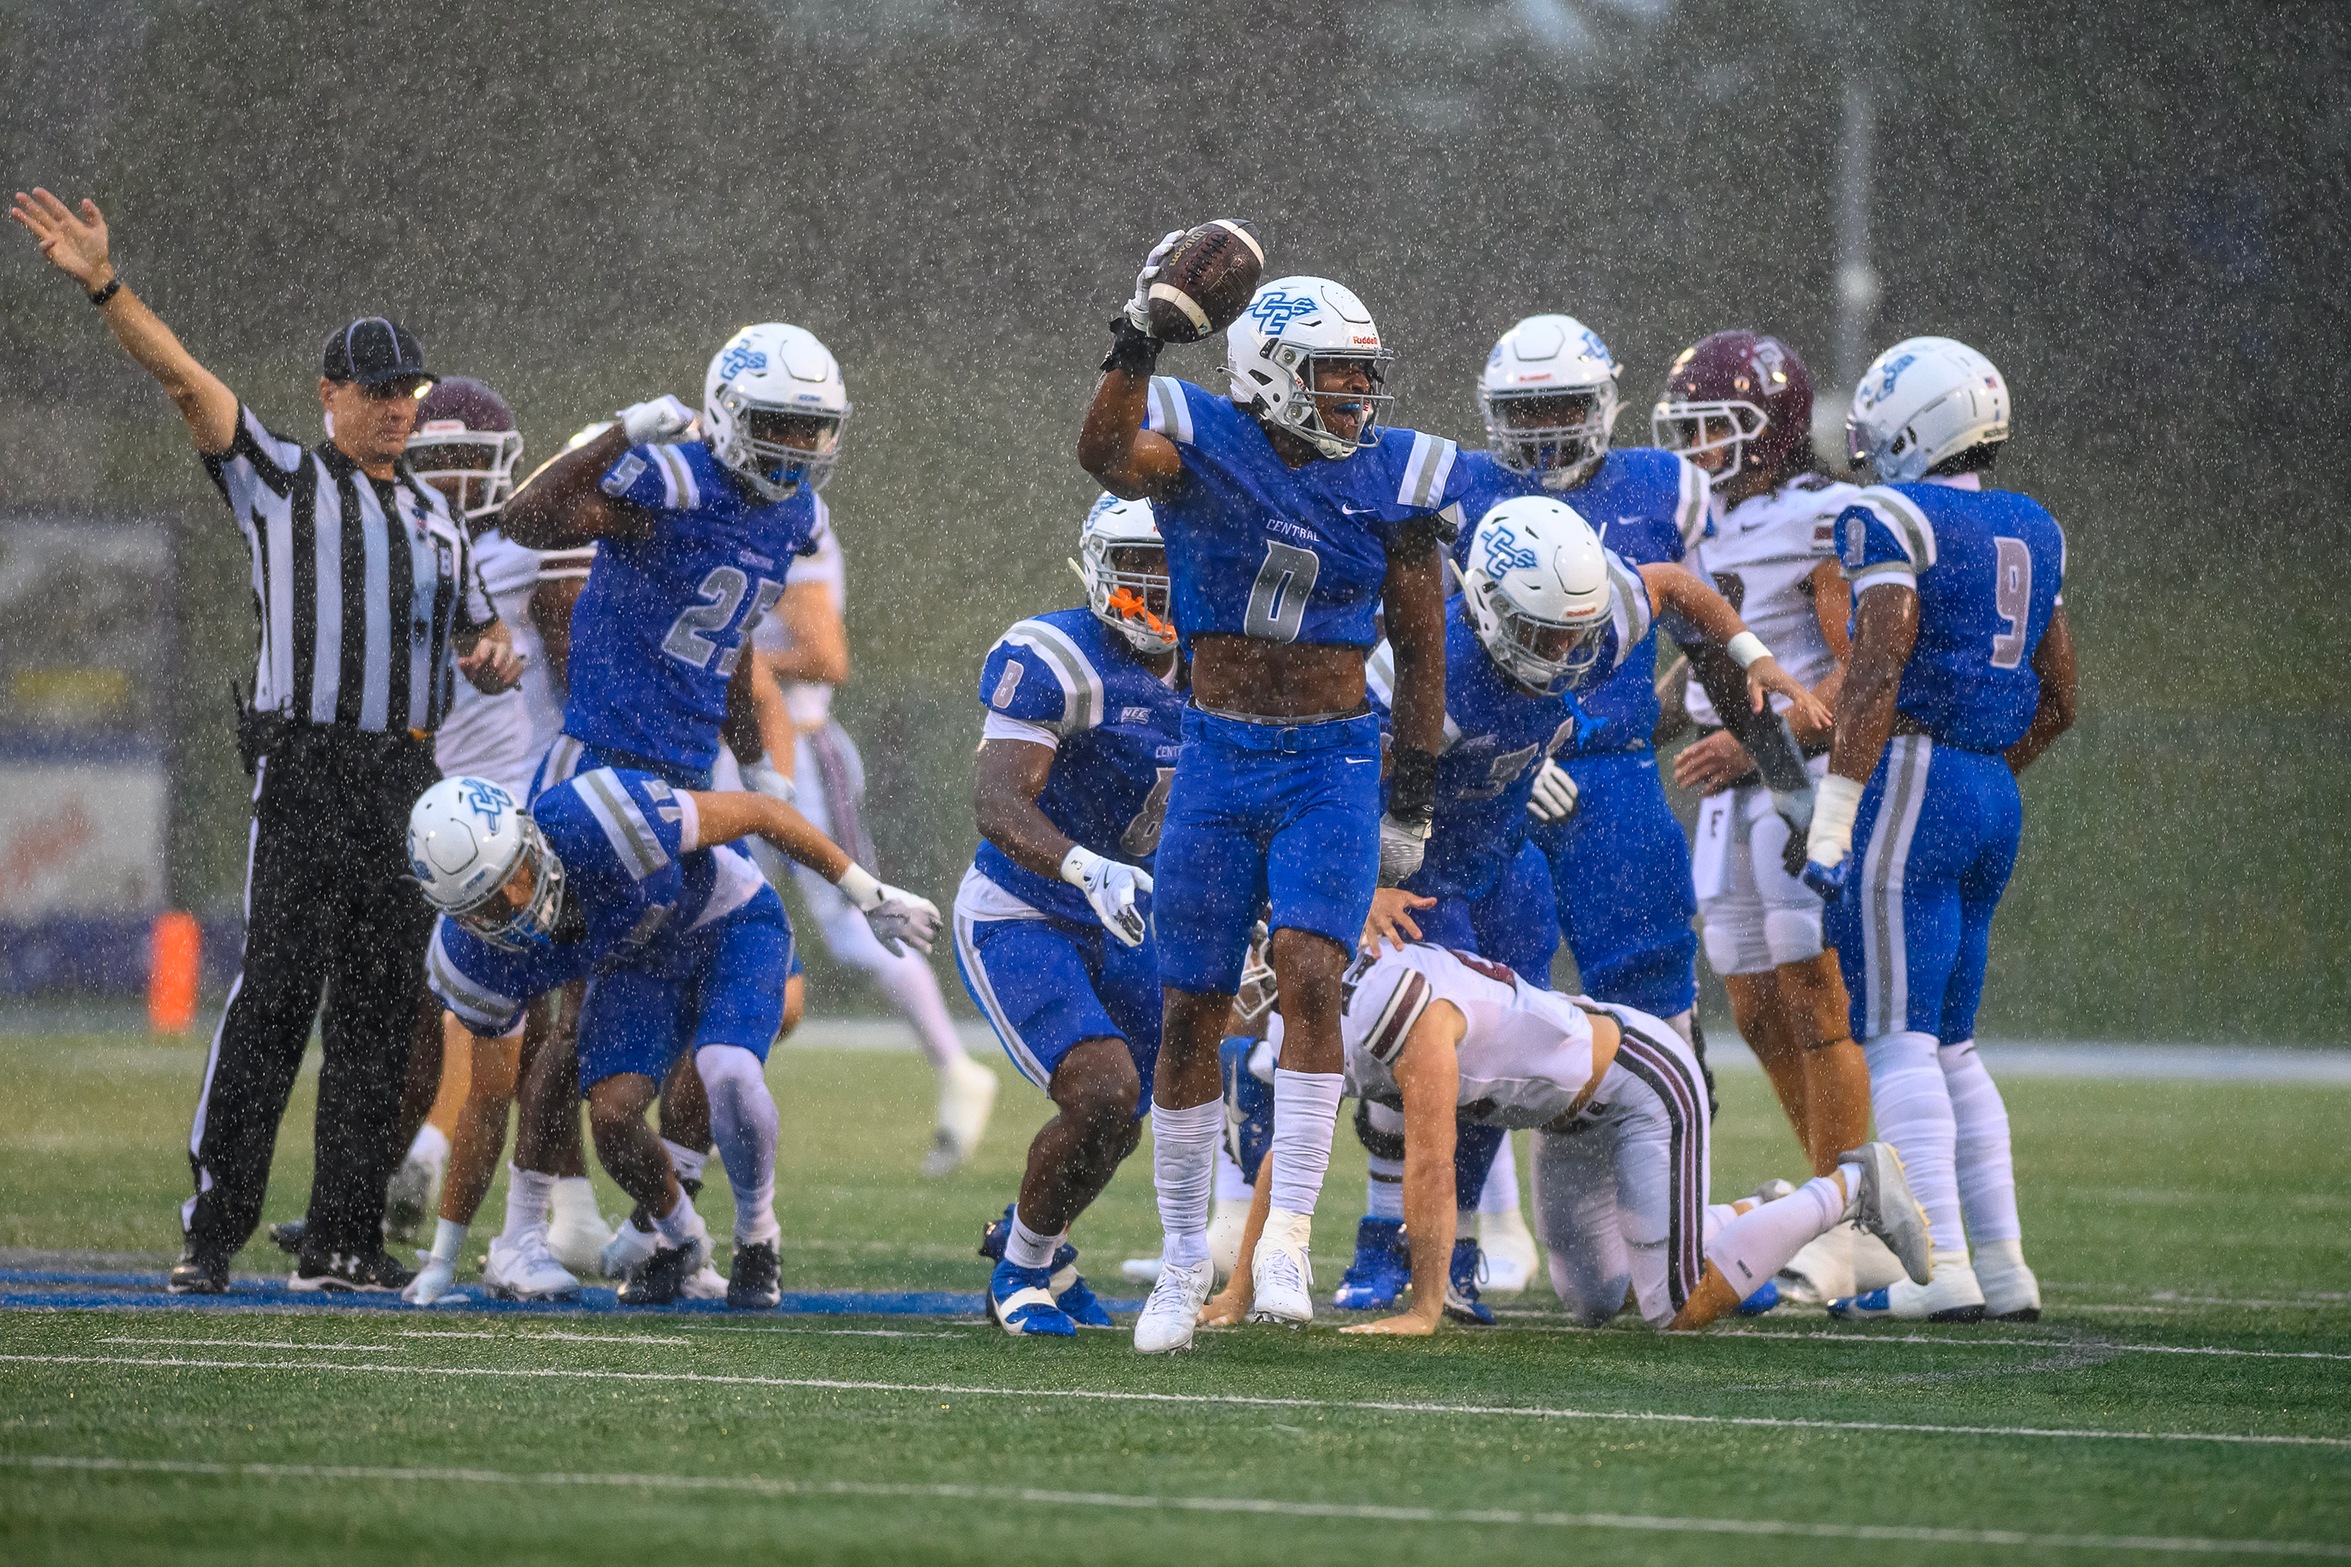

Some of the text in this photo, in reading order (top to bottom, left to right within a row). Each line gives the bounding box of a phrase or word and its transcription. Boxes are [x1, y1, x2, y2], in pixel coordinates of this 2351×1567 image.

[601, 450, 647, 497] 5
[1266, 518, 1320, 542] CENTRAL
[1244, 539, 1320, 643] 0
[1990, 536, 2032, 669] 9
[992, 659, 1024, 708] 8
[1155, 744, 1181, 758] CENT
